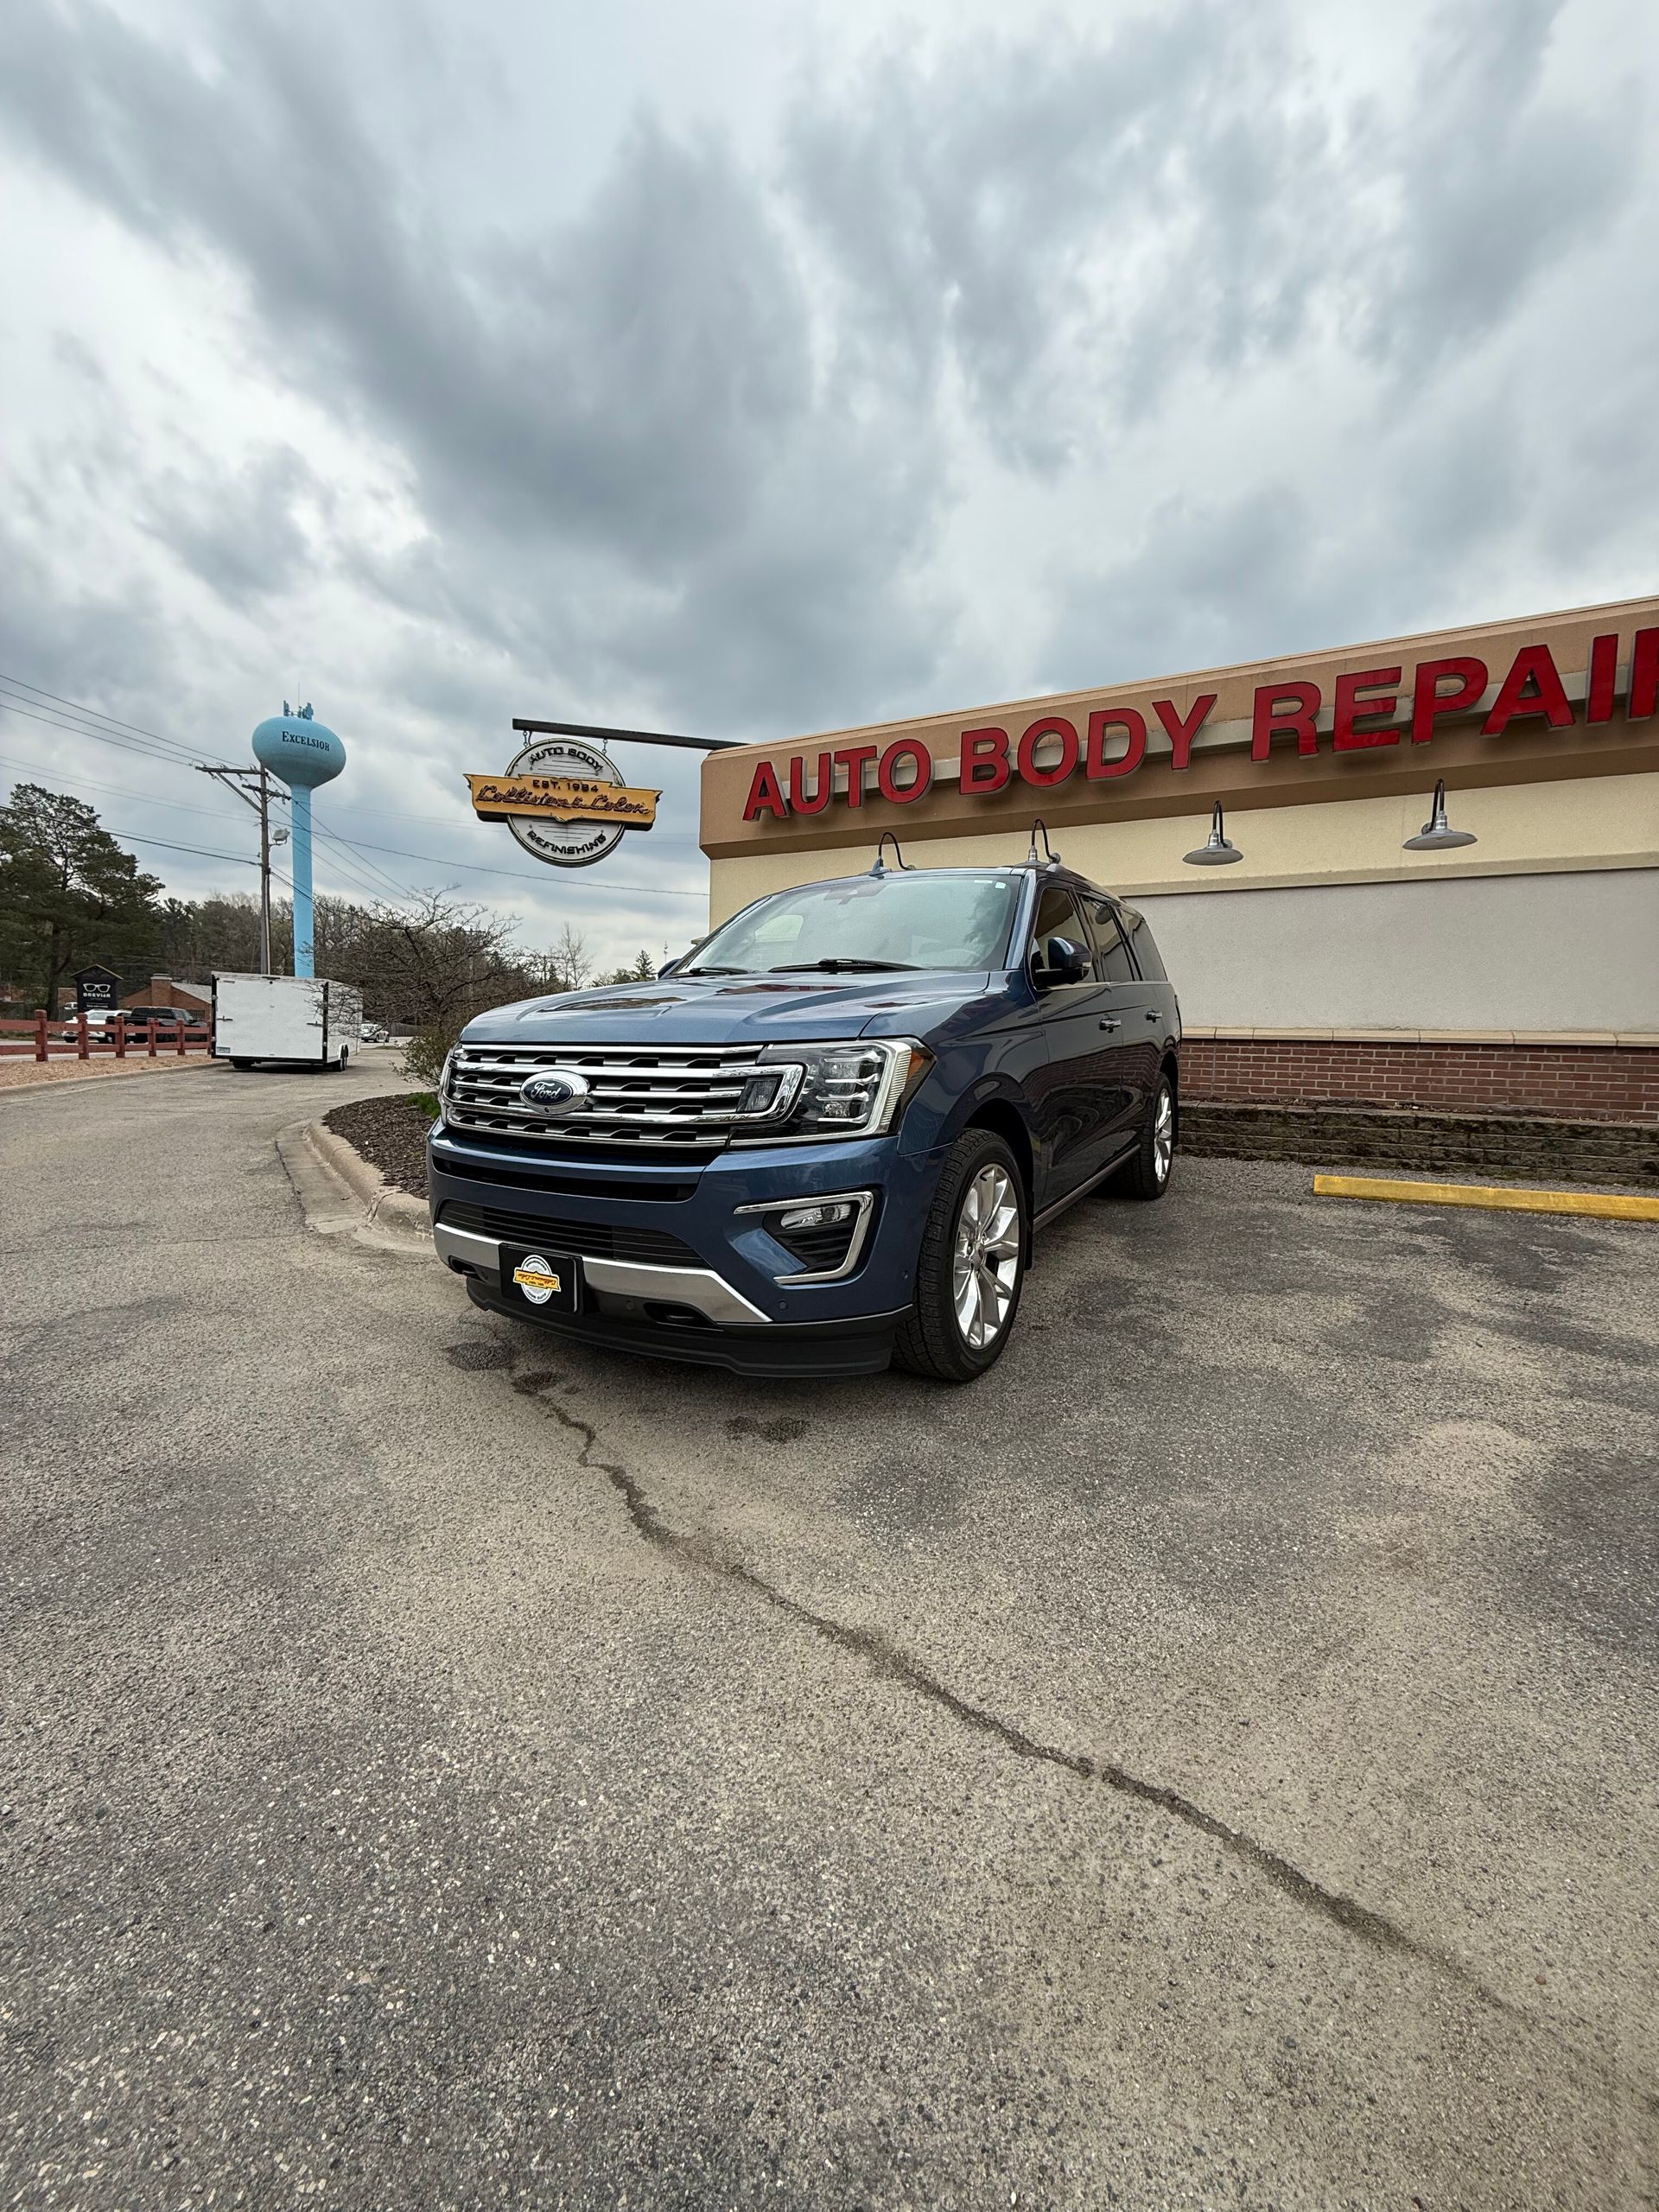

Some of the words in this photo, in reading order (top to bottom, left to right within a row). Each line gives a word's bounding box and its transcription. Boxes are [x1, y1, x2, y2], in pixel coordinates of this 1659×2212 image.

[282, 731, 330, 750] EXCELSIOR
[529, 747, 563, 765] AUTO
[568, 748, 603, 772] BODY
[742, 739, 931, 821] AUTO
[959, 694, 1217, 795] BODY
[532, 779, 561, 791] EST.
[567, 781, 599, 792] 1984
[527, 830, 607, 855] REFINISHING
[531, 1081, 562, 1098] Ford
